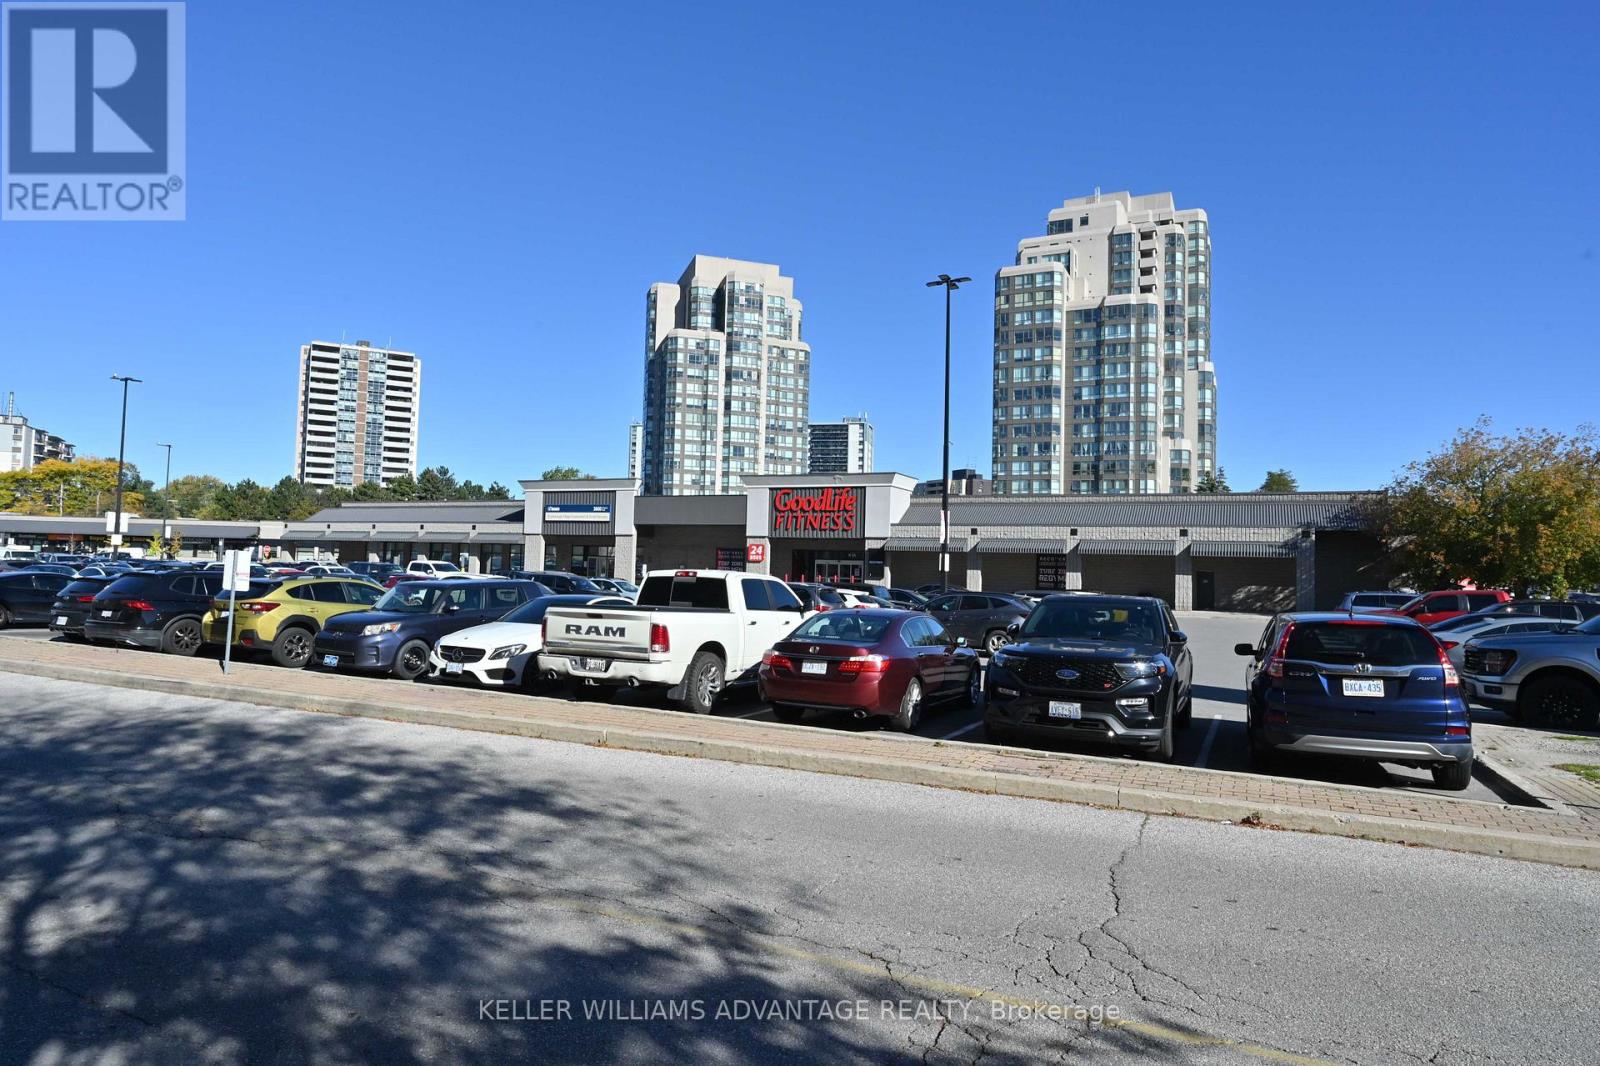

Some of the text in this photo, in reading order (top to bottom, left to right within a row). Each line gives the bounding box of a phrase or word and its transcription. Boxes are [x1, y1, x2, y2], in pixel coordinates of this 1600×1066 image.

[775, 512, 856, 530] FITNESS
[750, 545, 763, 555] 24
[565, 624, 626, 637] RAM
